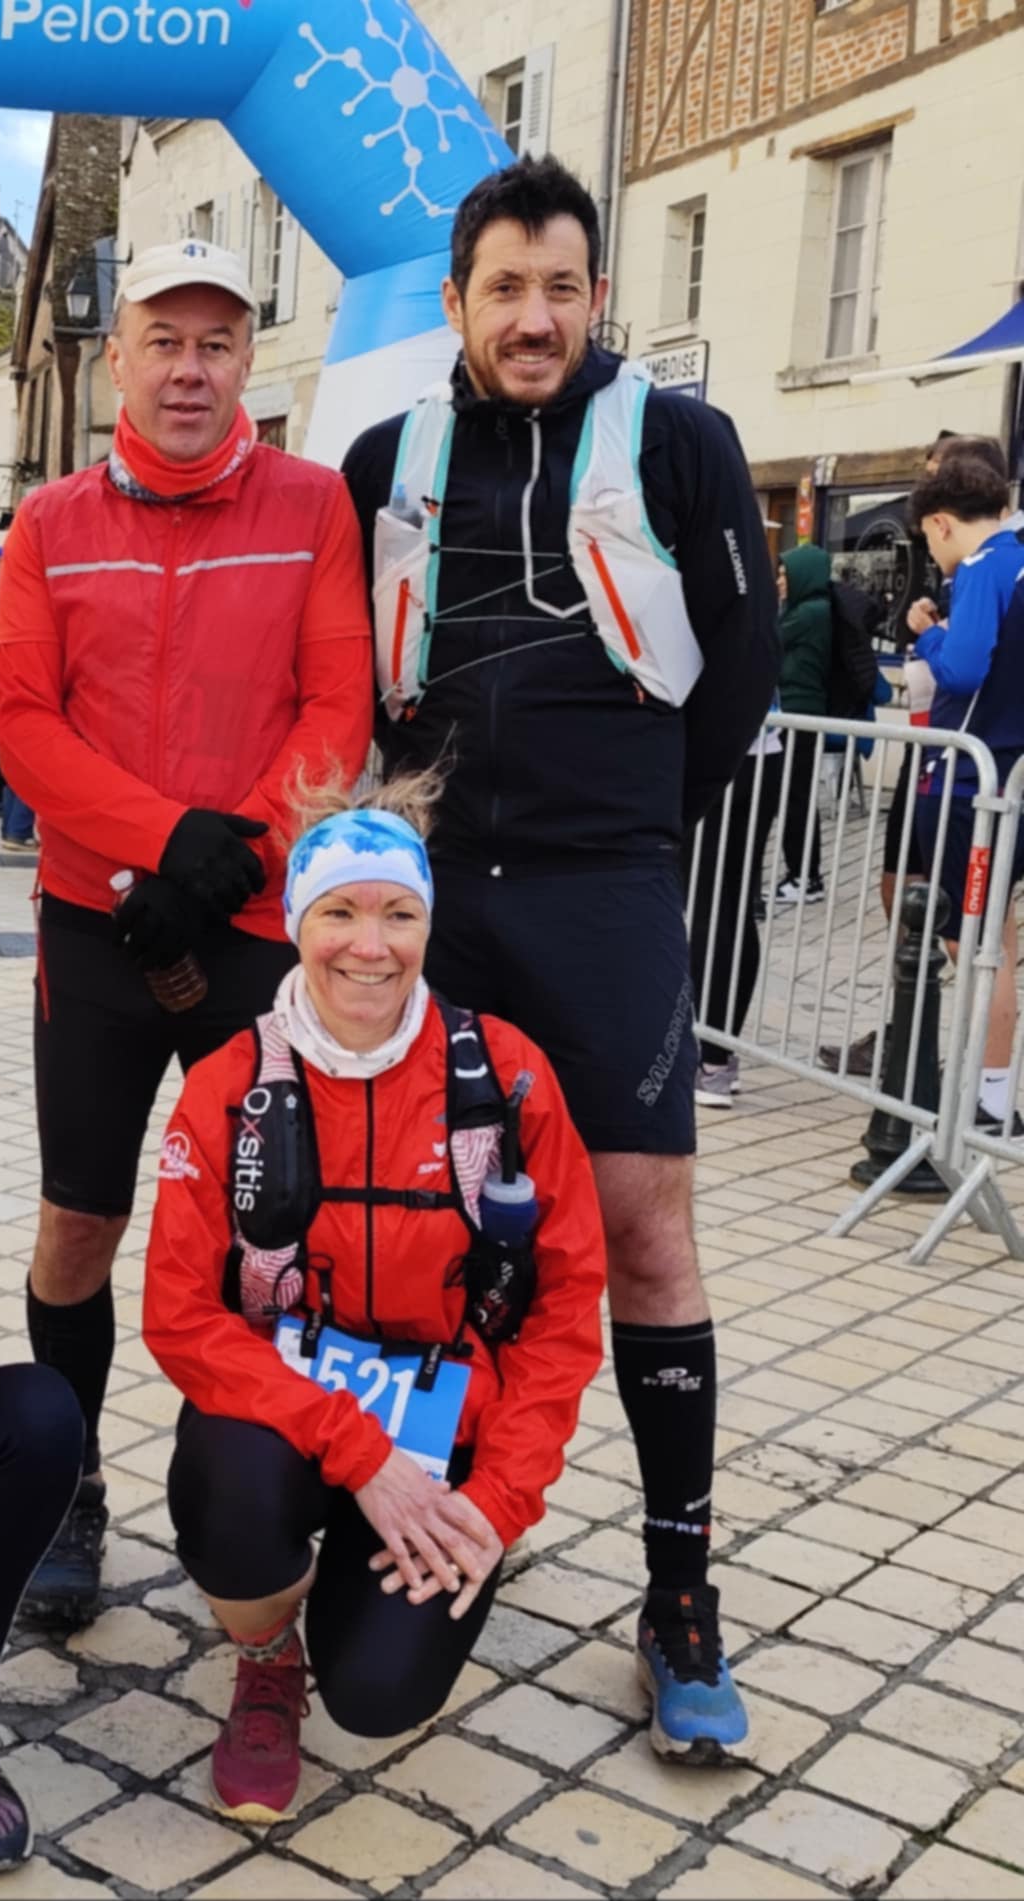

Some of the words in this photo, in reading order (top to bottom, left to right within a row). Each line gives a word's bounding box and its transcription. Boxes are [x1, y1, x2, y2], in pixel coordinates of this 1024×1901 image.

[0, 0, 231, 45] Peloton
[723, 527, 747, 595] SALOMON
[234, 1087, 273, 1212] Oxsitis
[316, 1345, 415, 1438] 521
